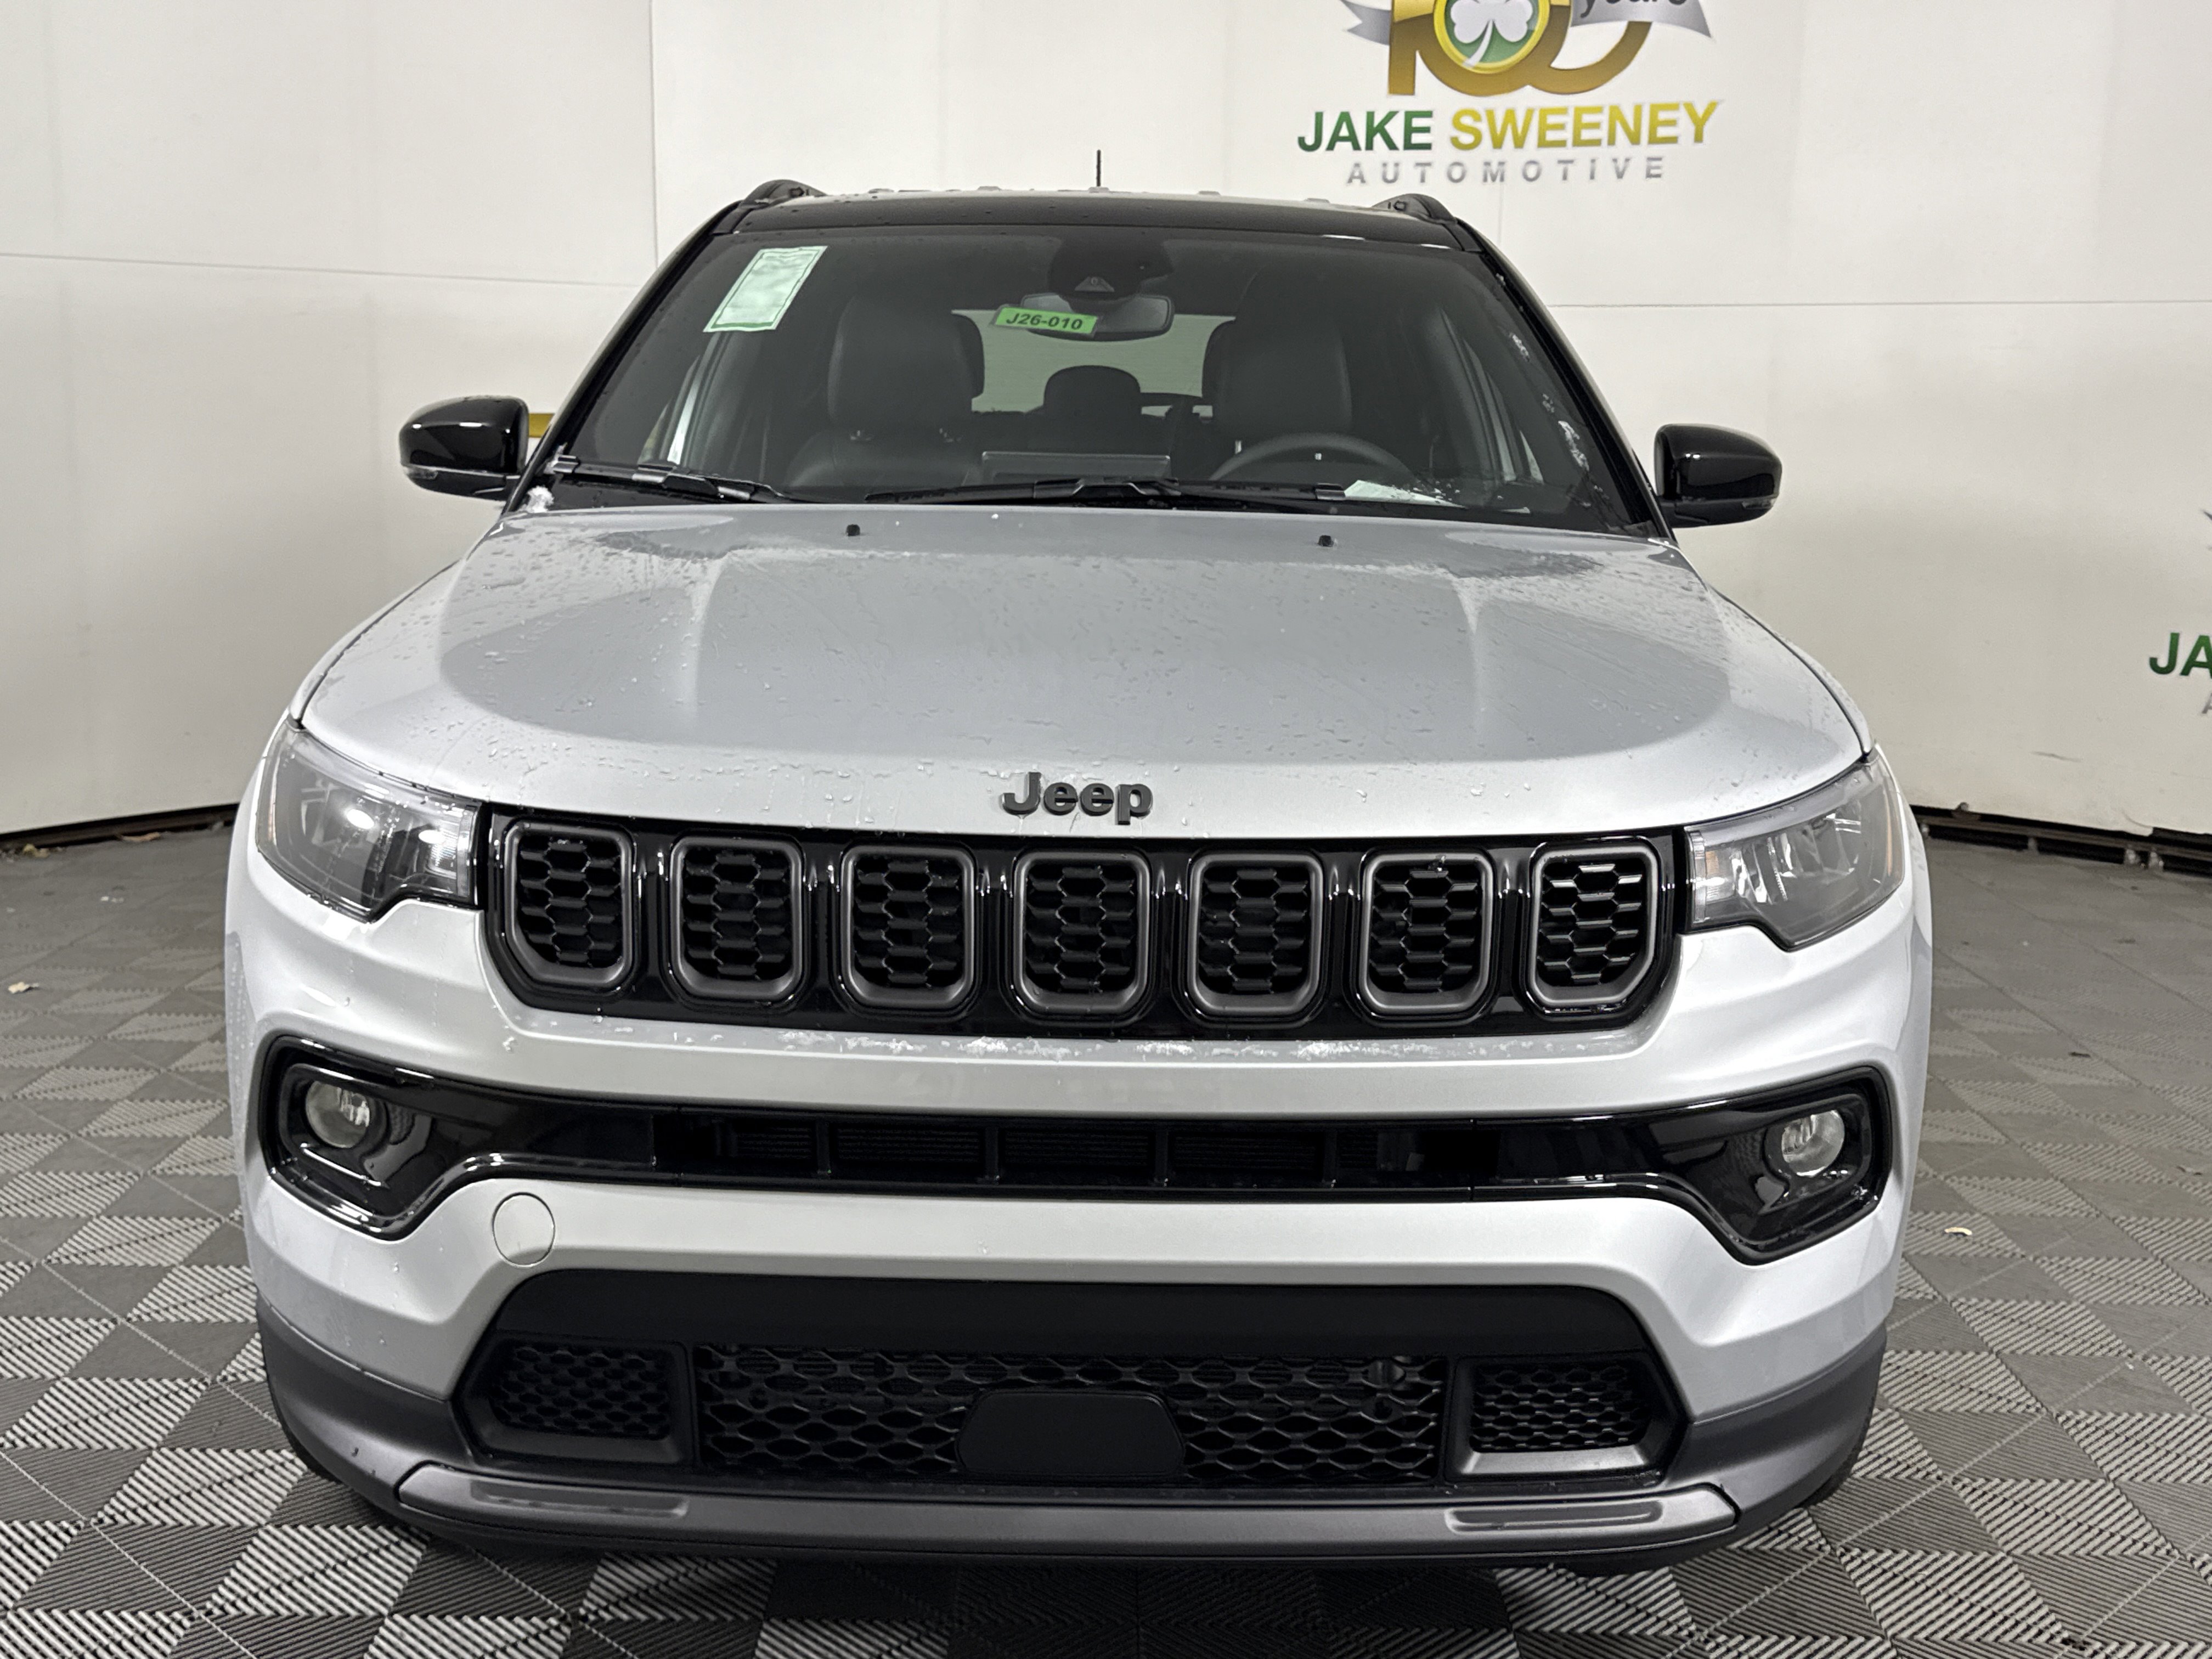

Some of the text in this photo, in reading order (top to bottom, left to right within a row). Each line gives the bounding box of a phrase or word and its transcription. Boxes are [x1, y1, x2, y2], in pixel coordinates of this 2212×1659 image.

[1297, 101, 1718, 152] JAKE SWEENEY
[1347, 156, 1663, 184] AUTOMOTIVE
[1006, 313, 1083, 330] J26-010
[1002, 772, 1153, 825] Jeep
